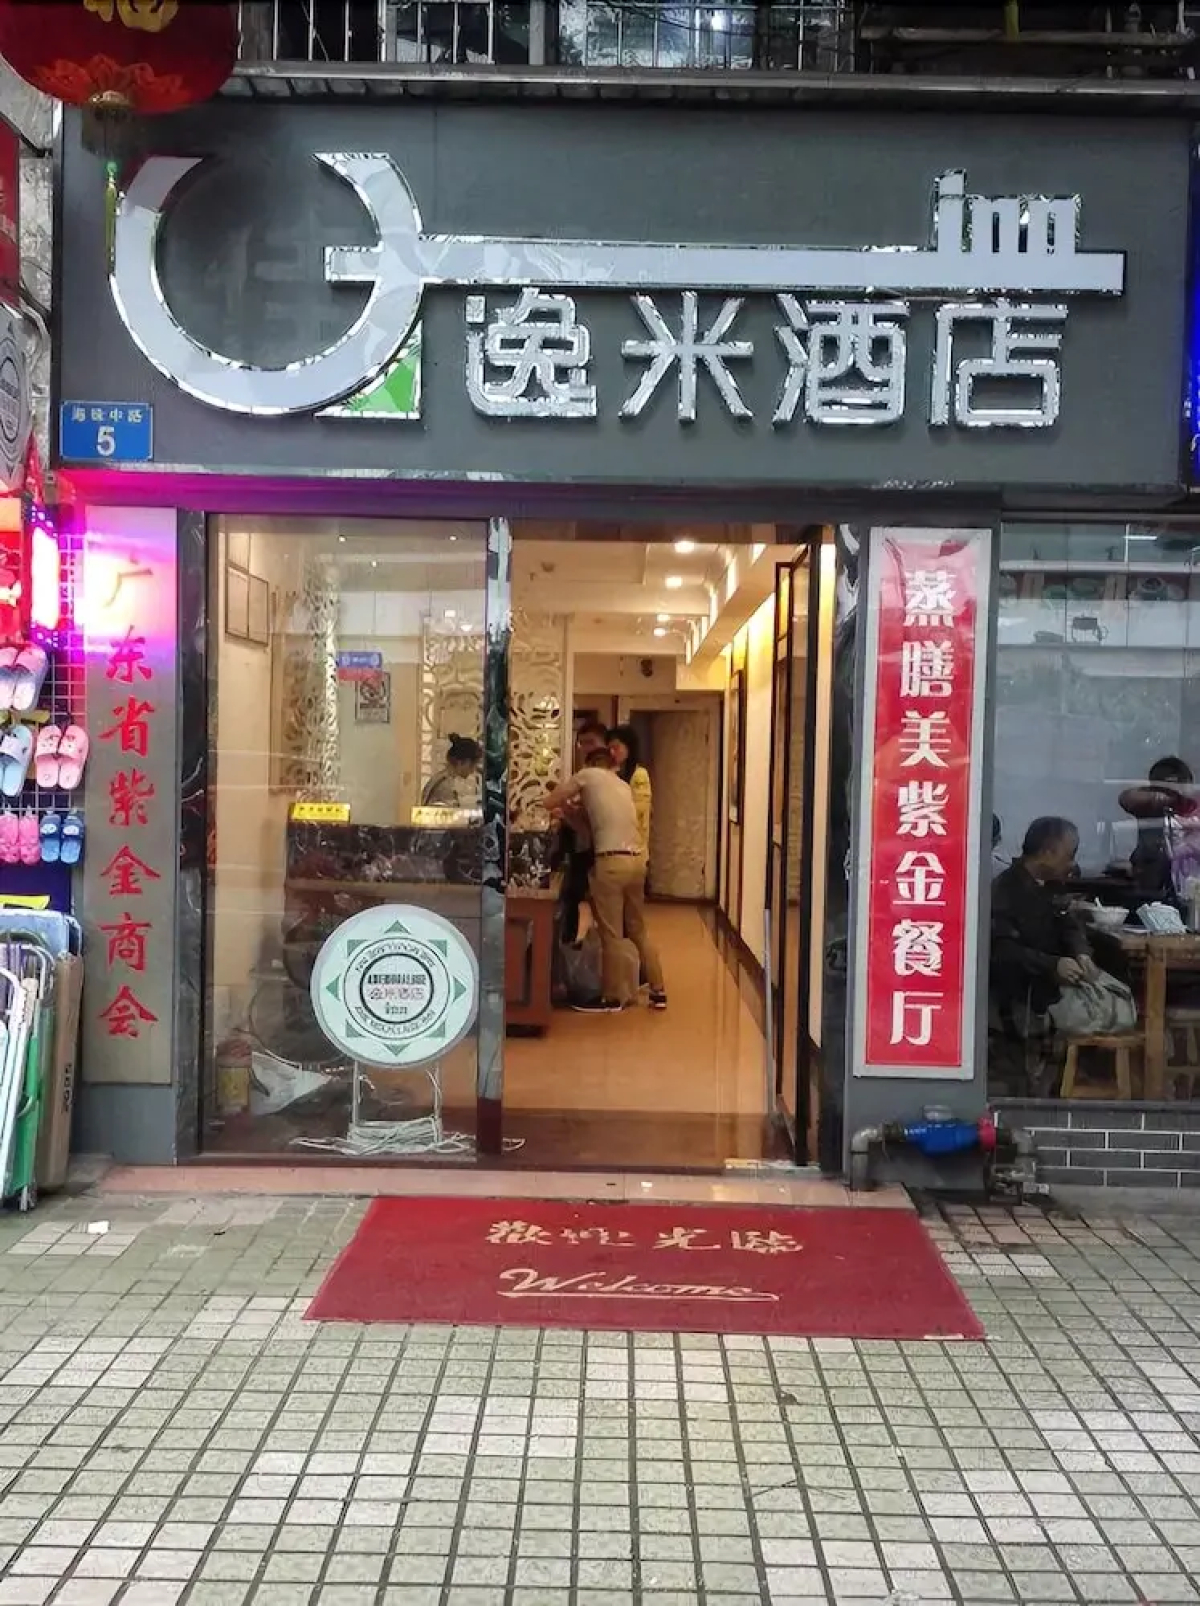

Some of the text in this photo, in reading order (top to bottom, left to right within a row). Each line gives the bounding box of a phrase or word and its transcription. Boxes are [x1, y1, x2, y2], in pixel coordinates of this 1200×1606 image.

[96, 425, 116, 457] 5
[466, 287, 1068, 427] 逸米酒店
[99, 554, 161, 1038] 广东省紫金商会
[889, 570, 957, 1046] 蒸膳美紫金餐厅
